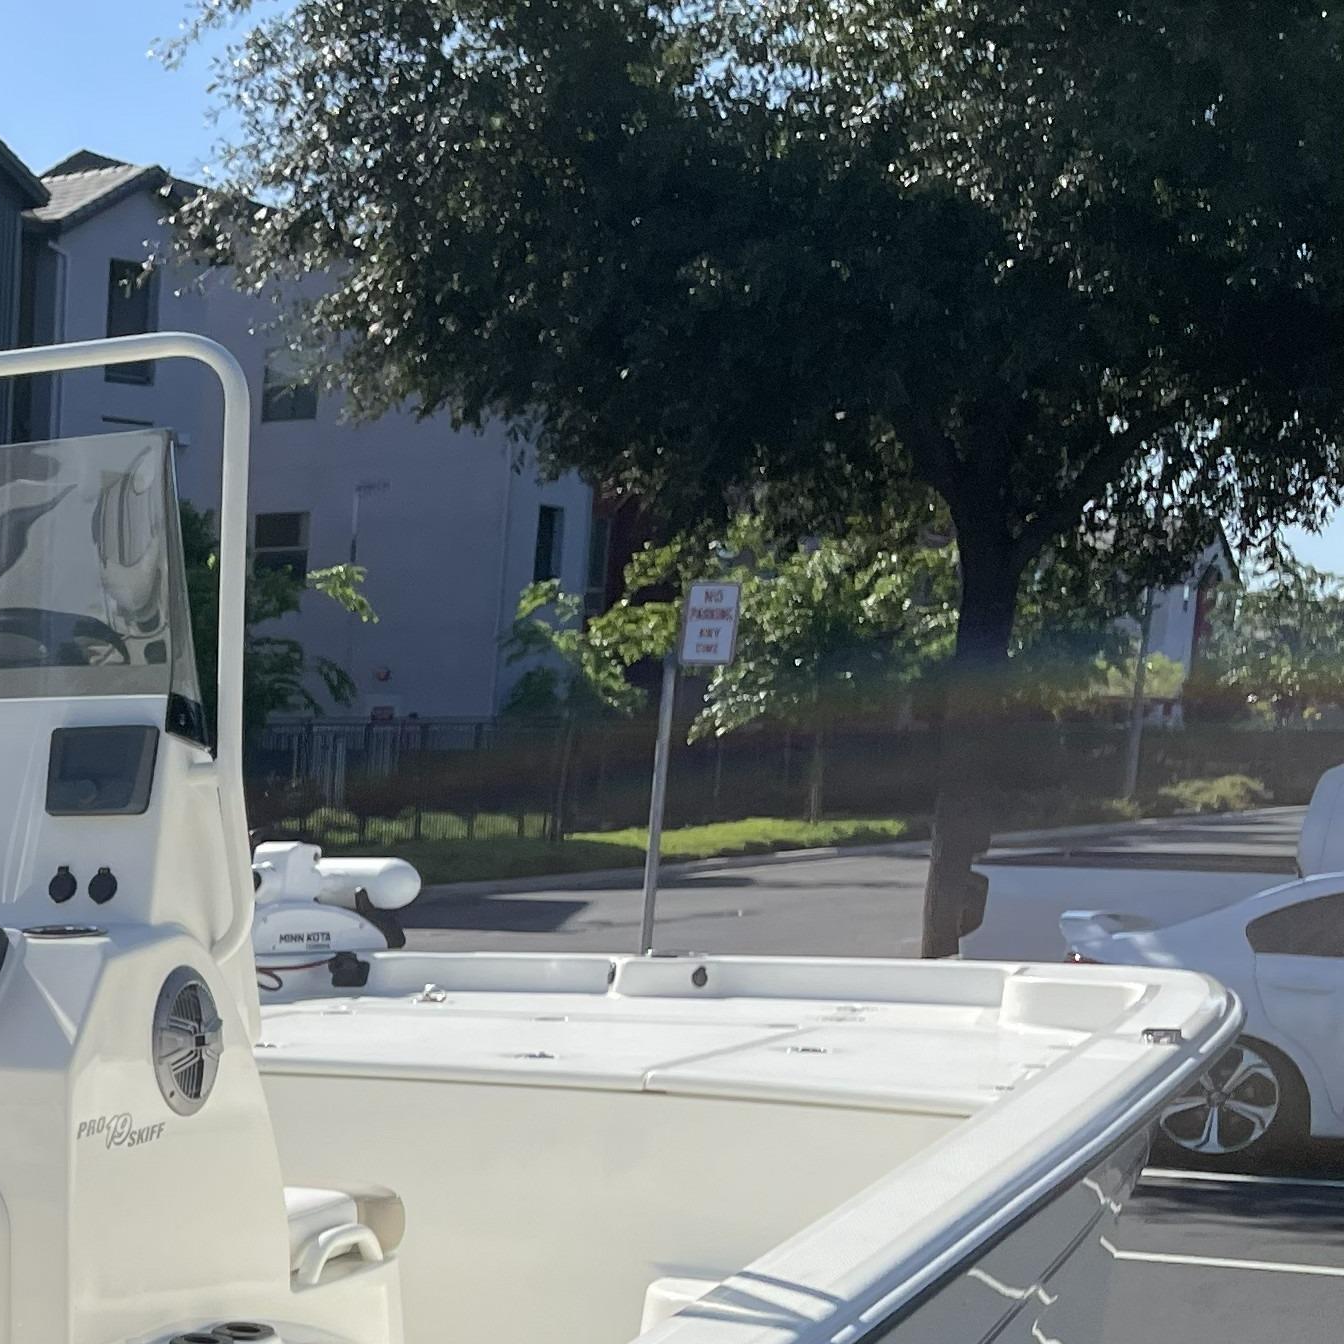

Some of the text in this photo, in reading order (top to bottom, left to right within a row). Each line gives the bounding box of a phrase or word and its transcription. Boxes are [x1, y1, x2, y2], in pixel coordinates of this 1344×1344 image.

[704, 590, 723, 603] NO
[279, 931, 330, 944] MINN KOTA
[76, 1112, 166, 1150] PRO 19 SKIFF
